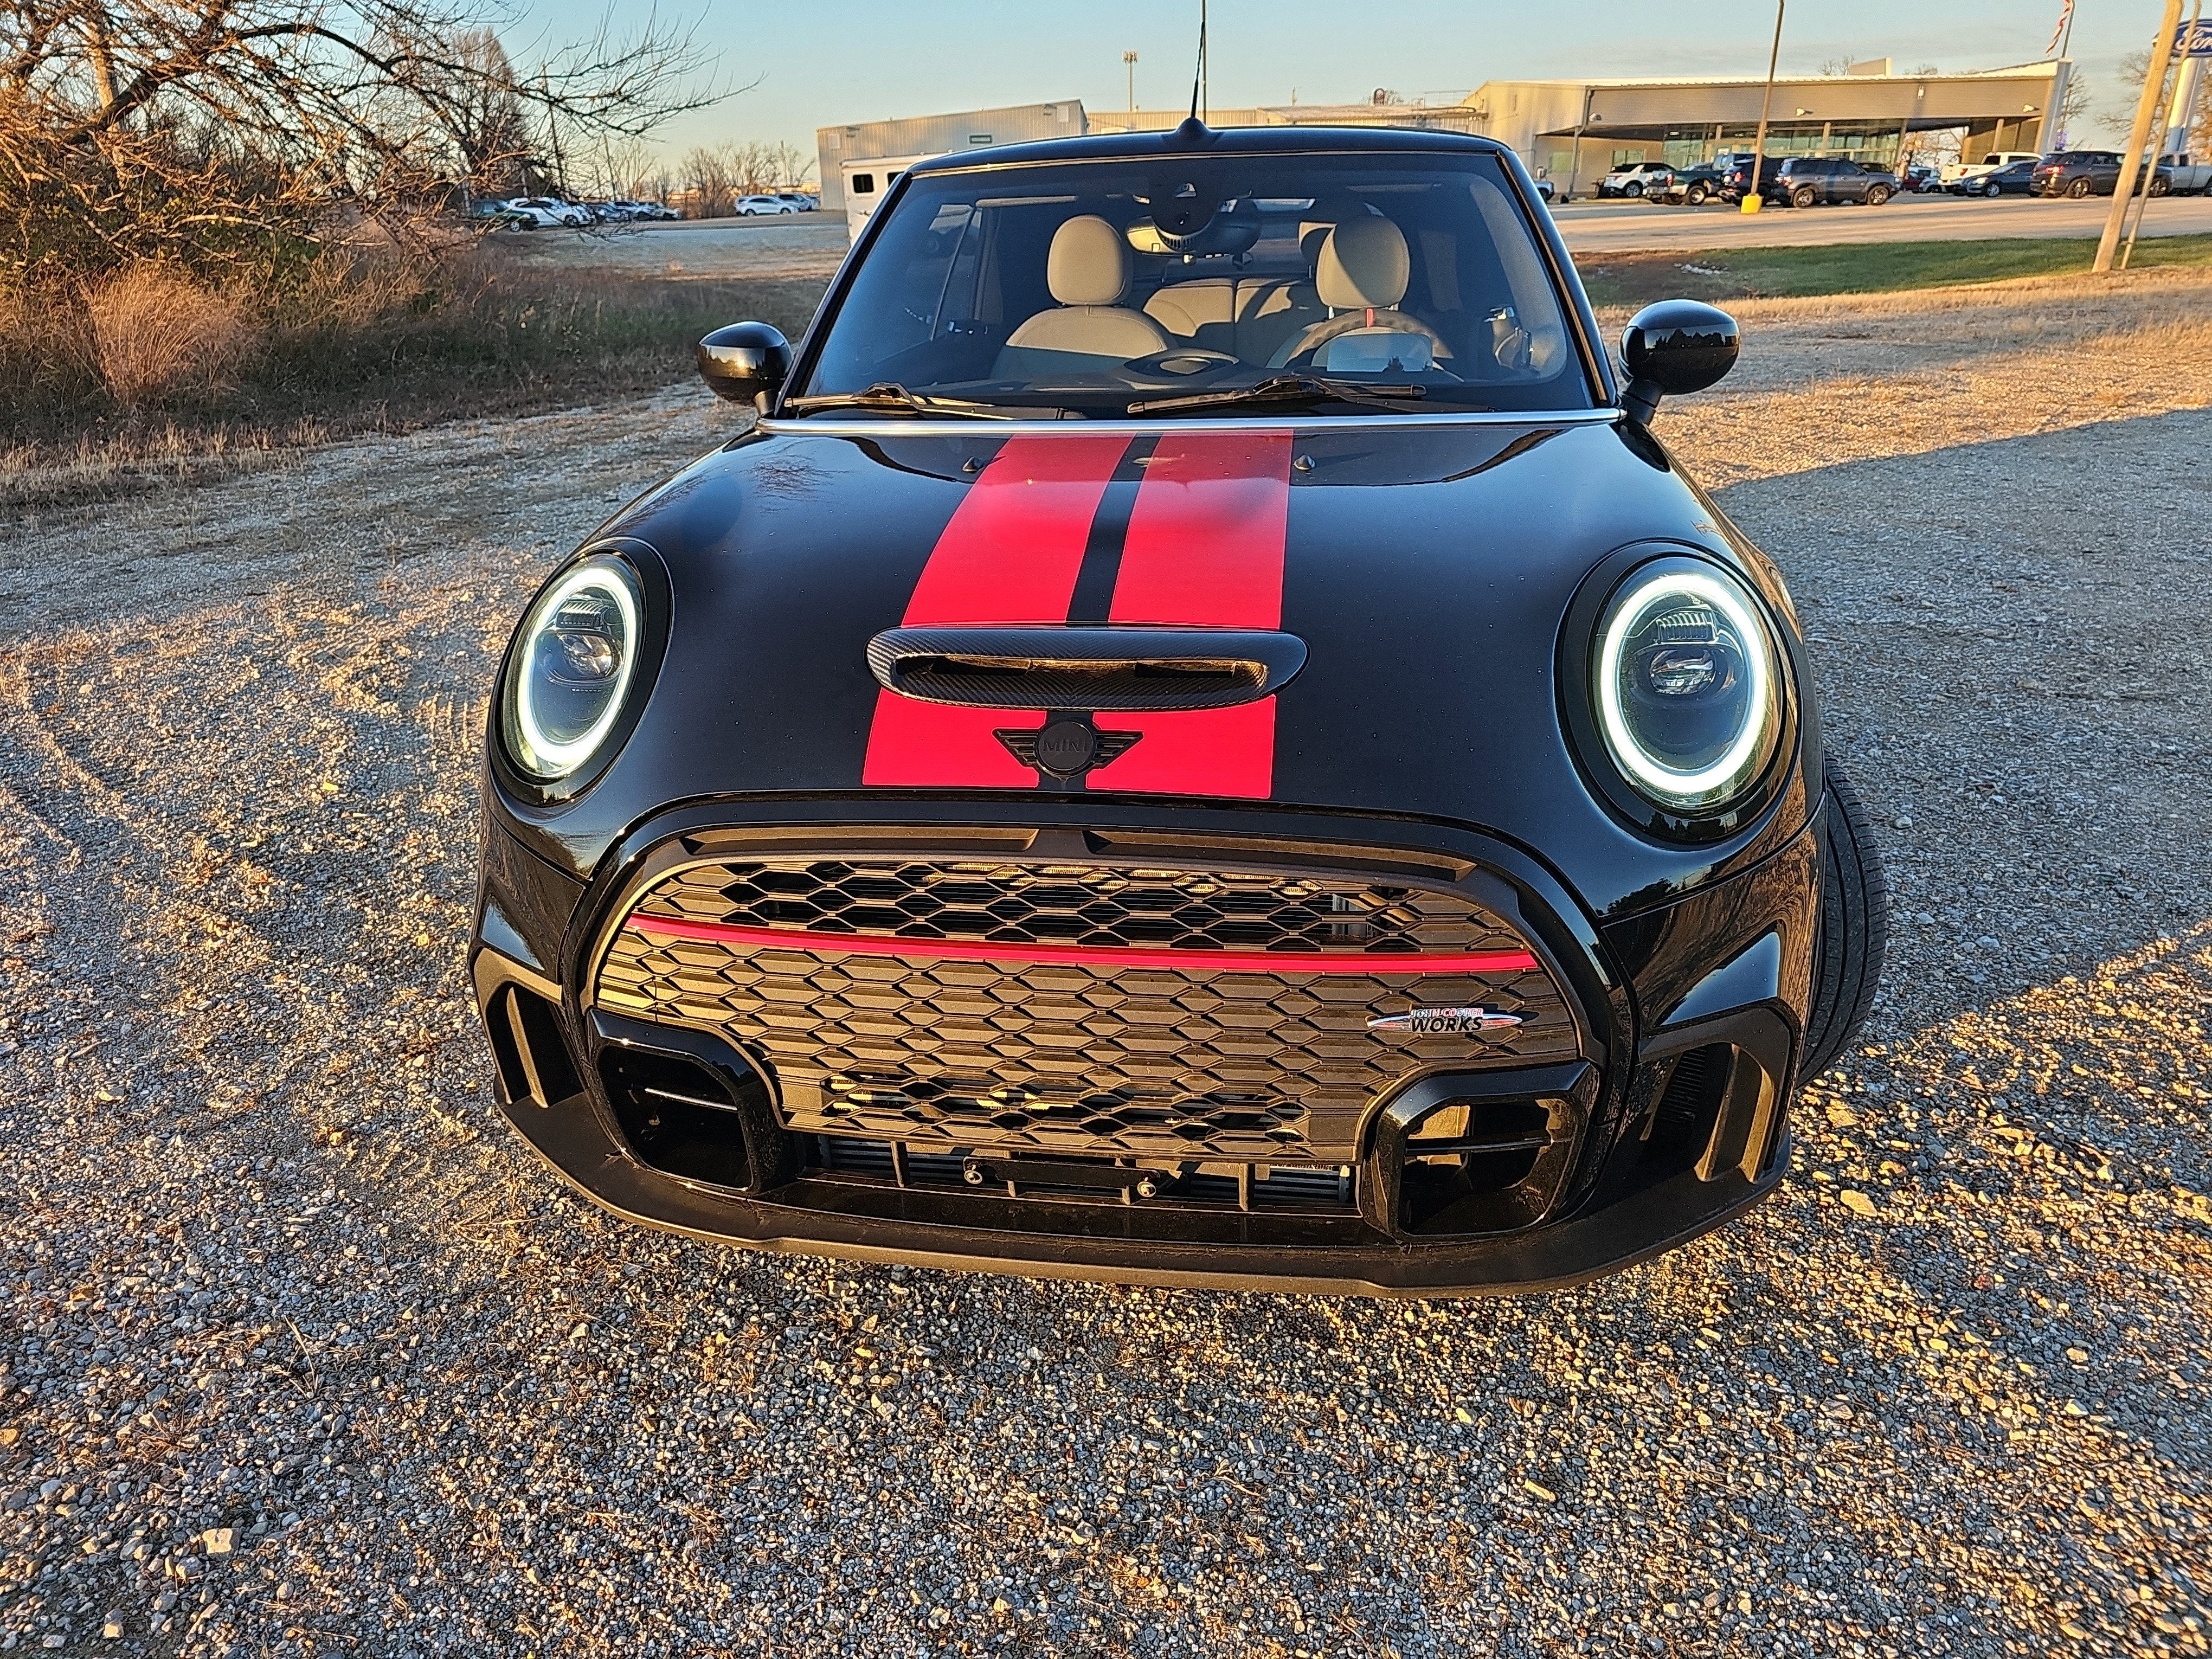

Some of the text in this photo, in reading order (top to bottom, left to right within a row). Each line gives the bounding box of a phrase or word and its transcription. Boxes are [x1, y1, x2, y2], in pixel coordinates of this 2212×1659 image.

[2175, 27, 2212, 50] For
[1042, 738, 1088, 753] MINI
[1411, 1008, 1483, 1018] JOHN COOPER
[1411, 1017, 1483, 1032] WORKS
